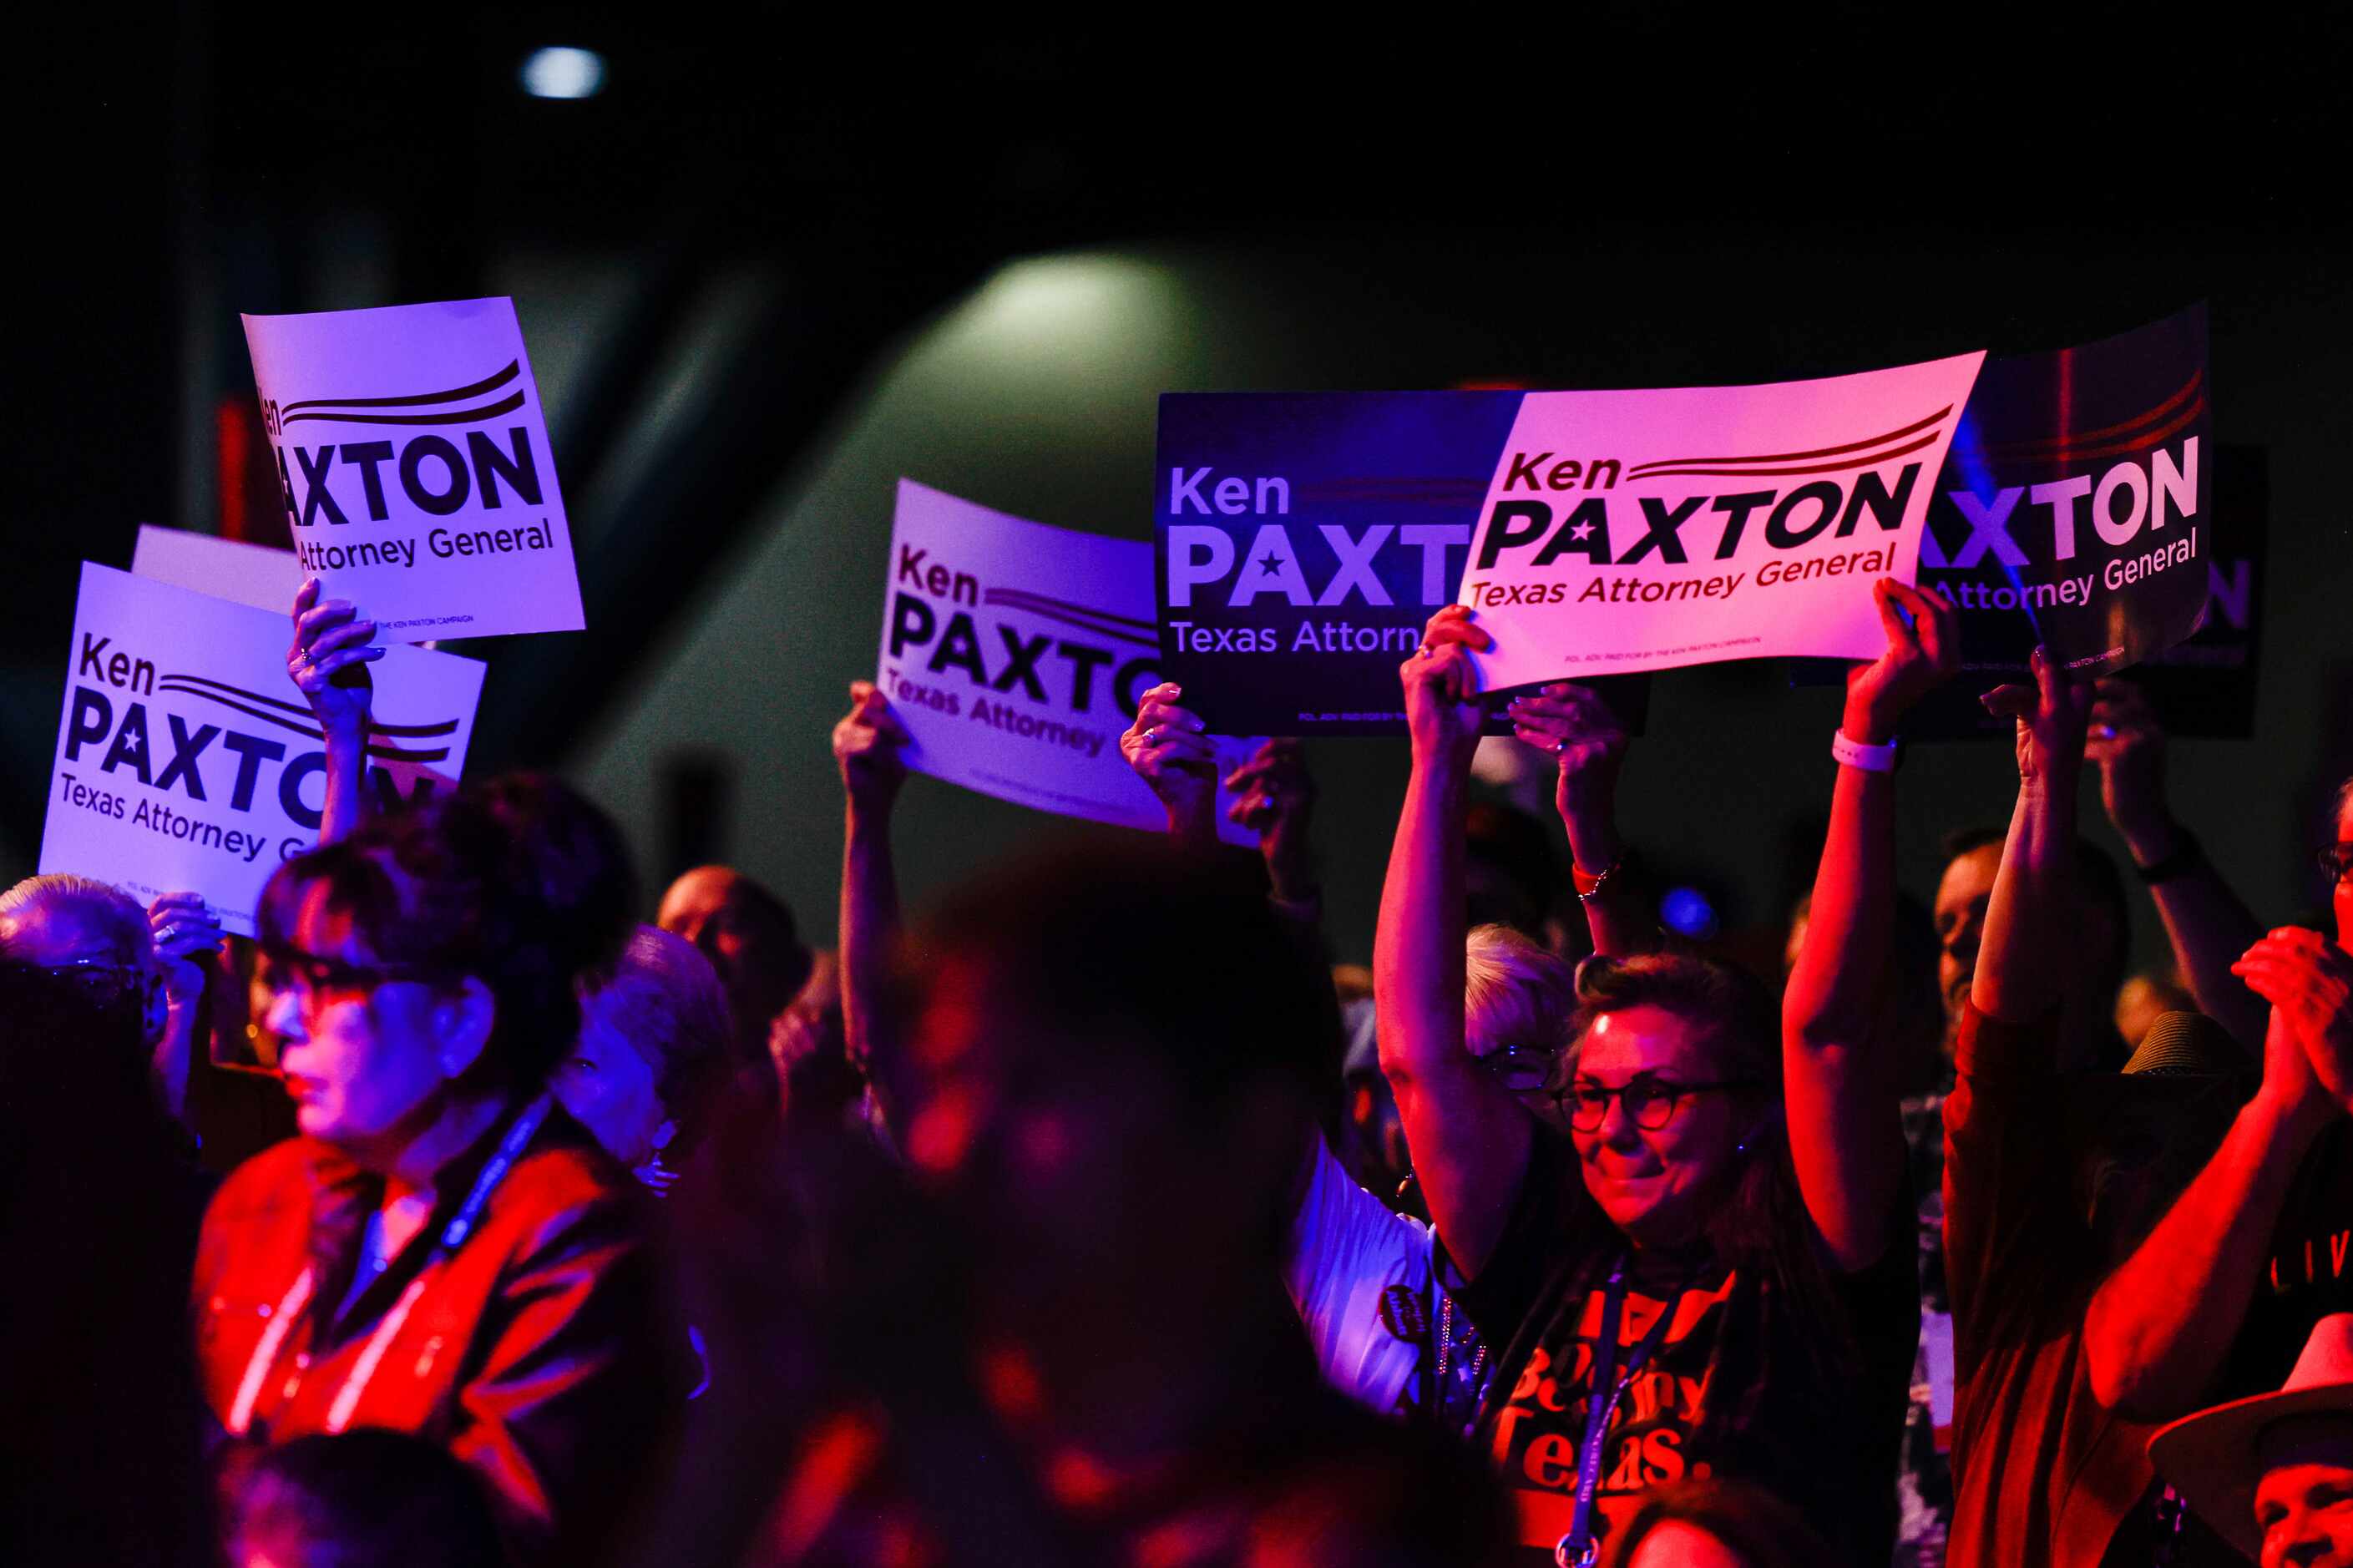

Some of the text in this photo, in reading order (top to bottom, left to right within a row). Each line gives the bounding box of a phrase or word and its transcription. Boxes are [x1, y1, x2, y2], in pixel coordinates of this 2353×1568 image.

[1171, 467, 1290, 515] Ken
[1503, 452, 1622, 492] Ken
[300, 518, 554, 570] Attorney General
[1475, 462, 1923, 570] PAXTON
[899, 544, 979, 607] Ken
[1168, 524, 1470, 608] PAXT
[1472, 542, 1897, 607] Texas Attorney General
[2104, 527, 2197, 591] General
[78, 632, 155, 696] Ken
[889, 591, 1162, 721] PAXTO
[1169, 621, 1420, 652] Texas Attorn
[887, 668, 1106, 758] Texas Attorney
[61, 773, 125, 819] Texas
[132, 798, 266, 862] Attorney
